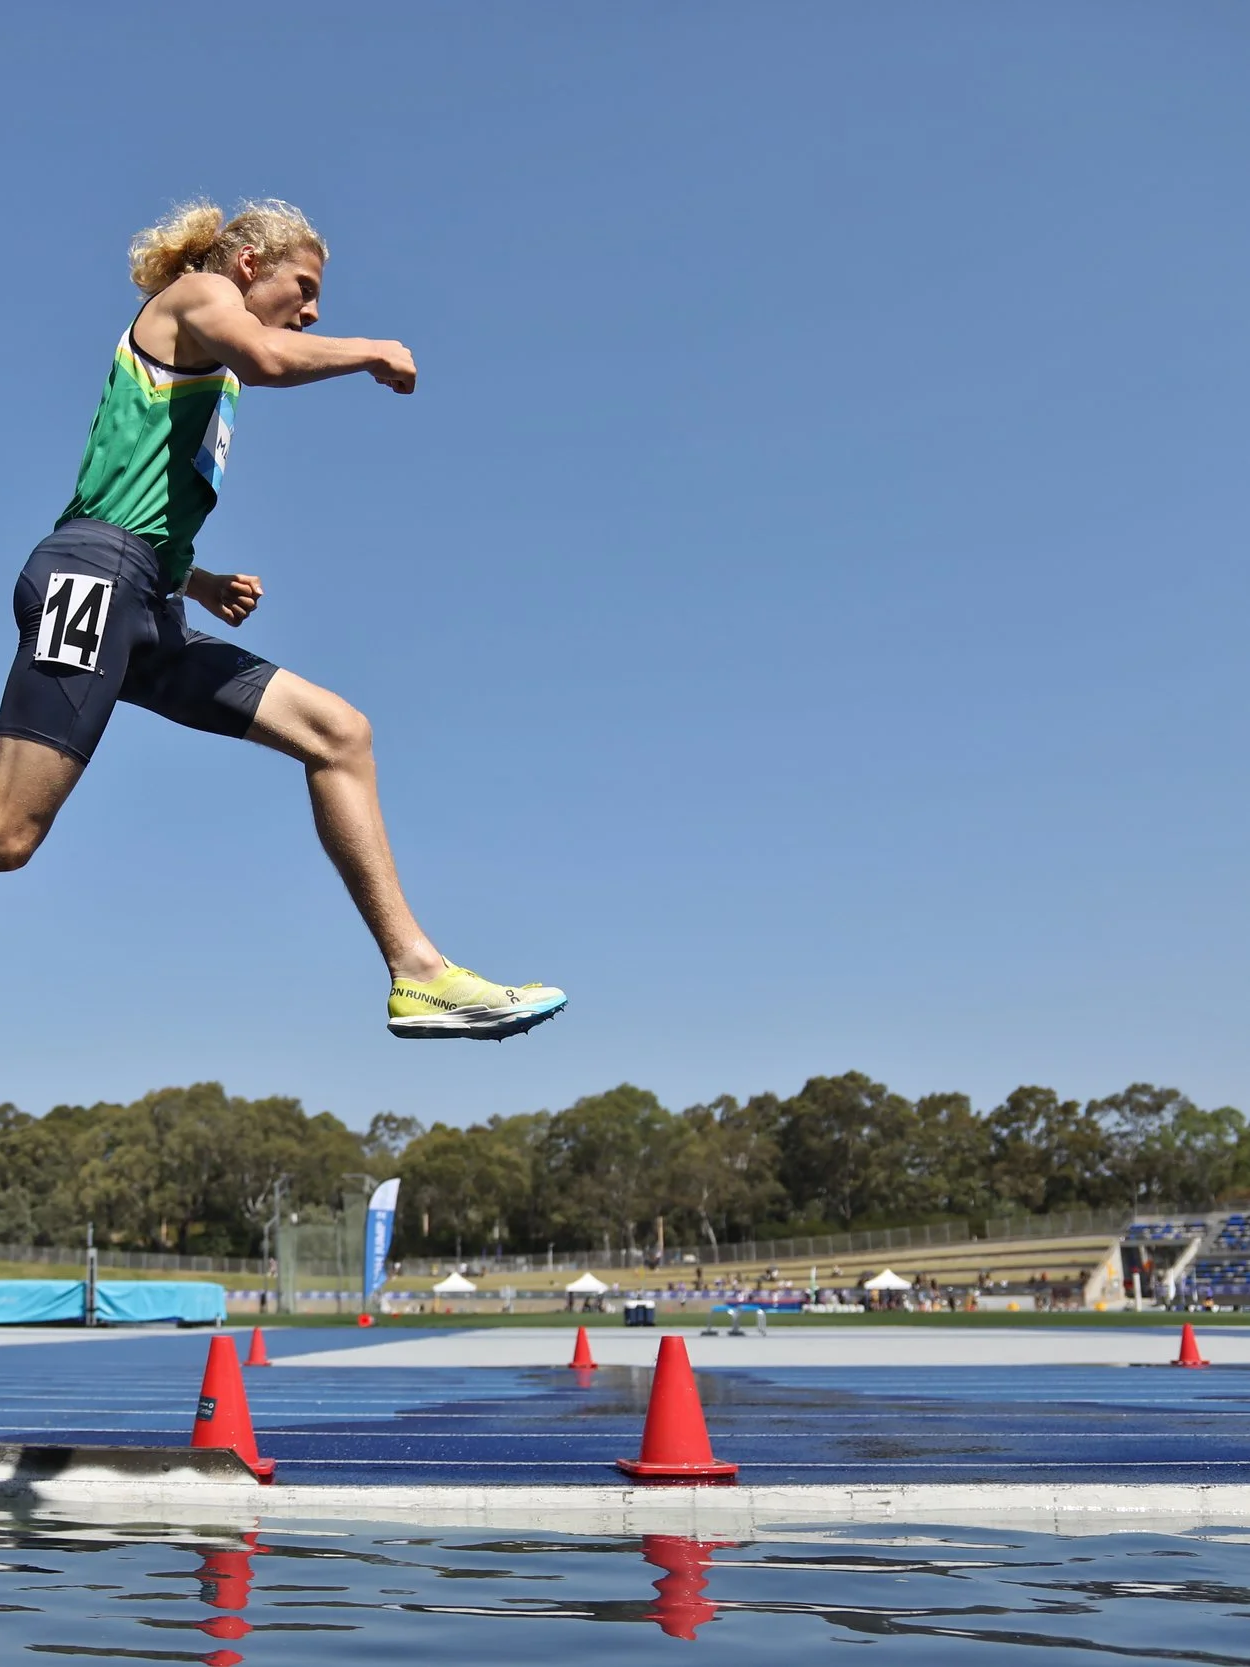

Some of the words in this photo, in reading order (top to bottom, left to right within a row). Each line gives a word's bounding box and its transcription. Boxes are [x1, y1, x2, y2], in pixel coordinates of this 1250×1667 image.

[46, 578, 105, 666] 14
[390, 987, 405, 997] ON
[406, 989, 458, 1011] RUNNING
